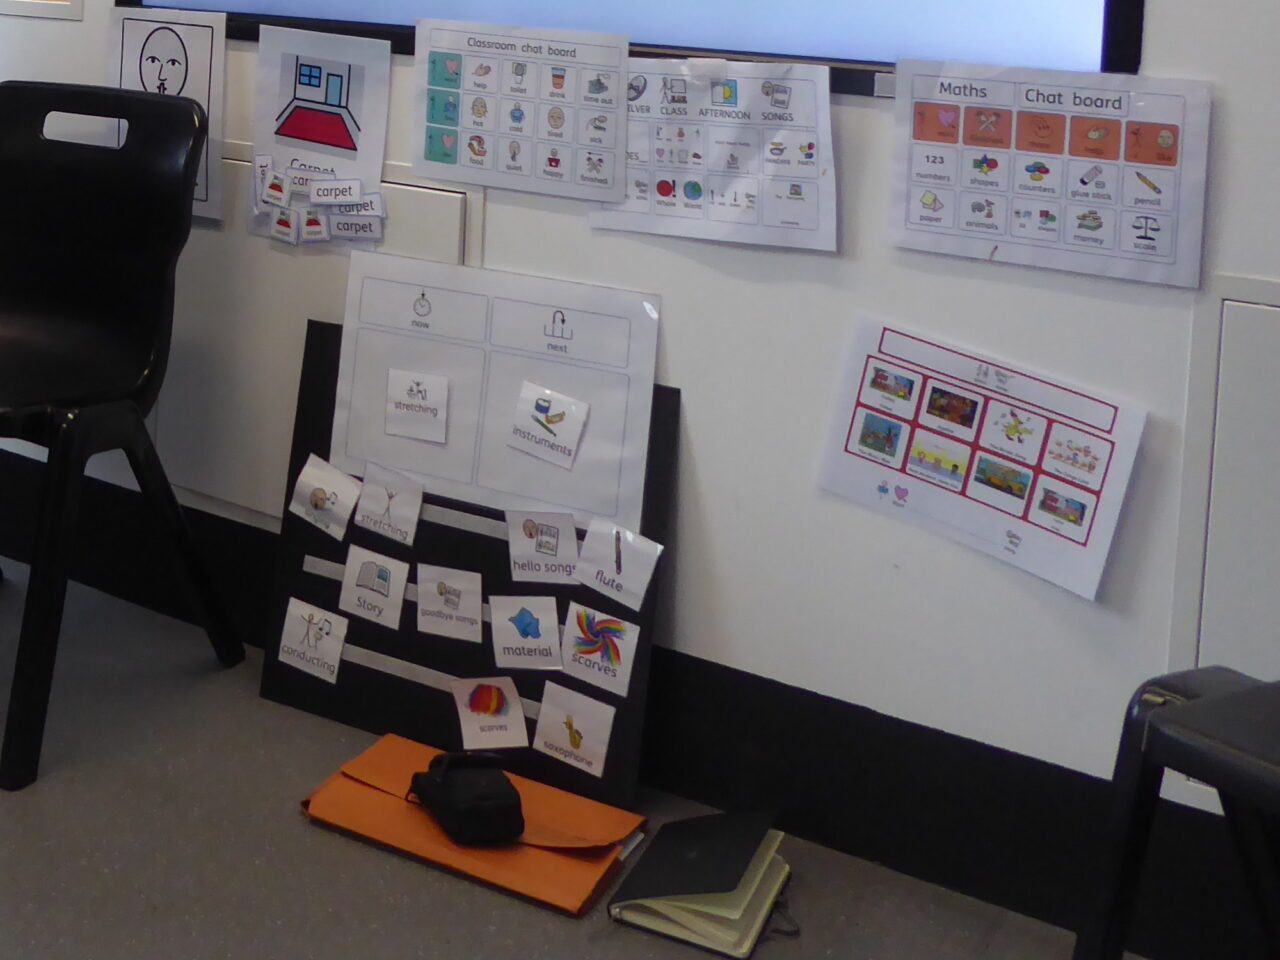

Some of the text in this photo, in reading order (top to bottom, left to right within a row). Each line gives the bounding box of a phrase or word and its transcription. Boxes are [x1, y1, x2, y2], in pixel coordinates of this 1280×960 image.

[467, 36, 577, 58] Classroom chat board
[939, 81, 988, 99] Maths
[1024, 88, 1123, 110] Chat board
[626, 104, 794, 122] ILVER CLASS AFTERNOON SONGS
[925, 154, 945, 165] 123
[915, 172, 951, 182] numbers
[316, 185, 353, 199] carpet
[336, 222, 373, 235] carpet
[411, 320, 431, 330] now
[547, 341, 569, 355] next
[393, 399, 439, 418] stretching
[511, 423, 574, 458] instruments
[361, 513, 409, 542] stretching
[513, 559, 542, 573] hello
[595, 569, 624, 592] flute
[356, 596, 384, 618] Story
[420, 607, 454, 622] goodbye
[281, 644, 336, 675] conducting
[502, 644, 553, 658] material
[571, 653, 618, 678] scarves
[543, 740, 594, 768] saxophone
